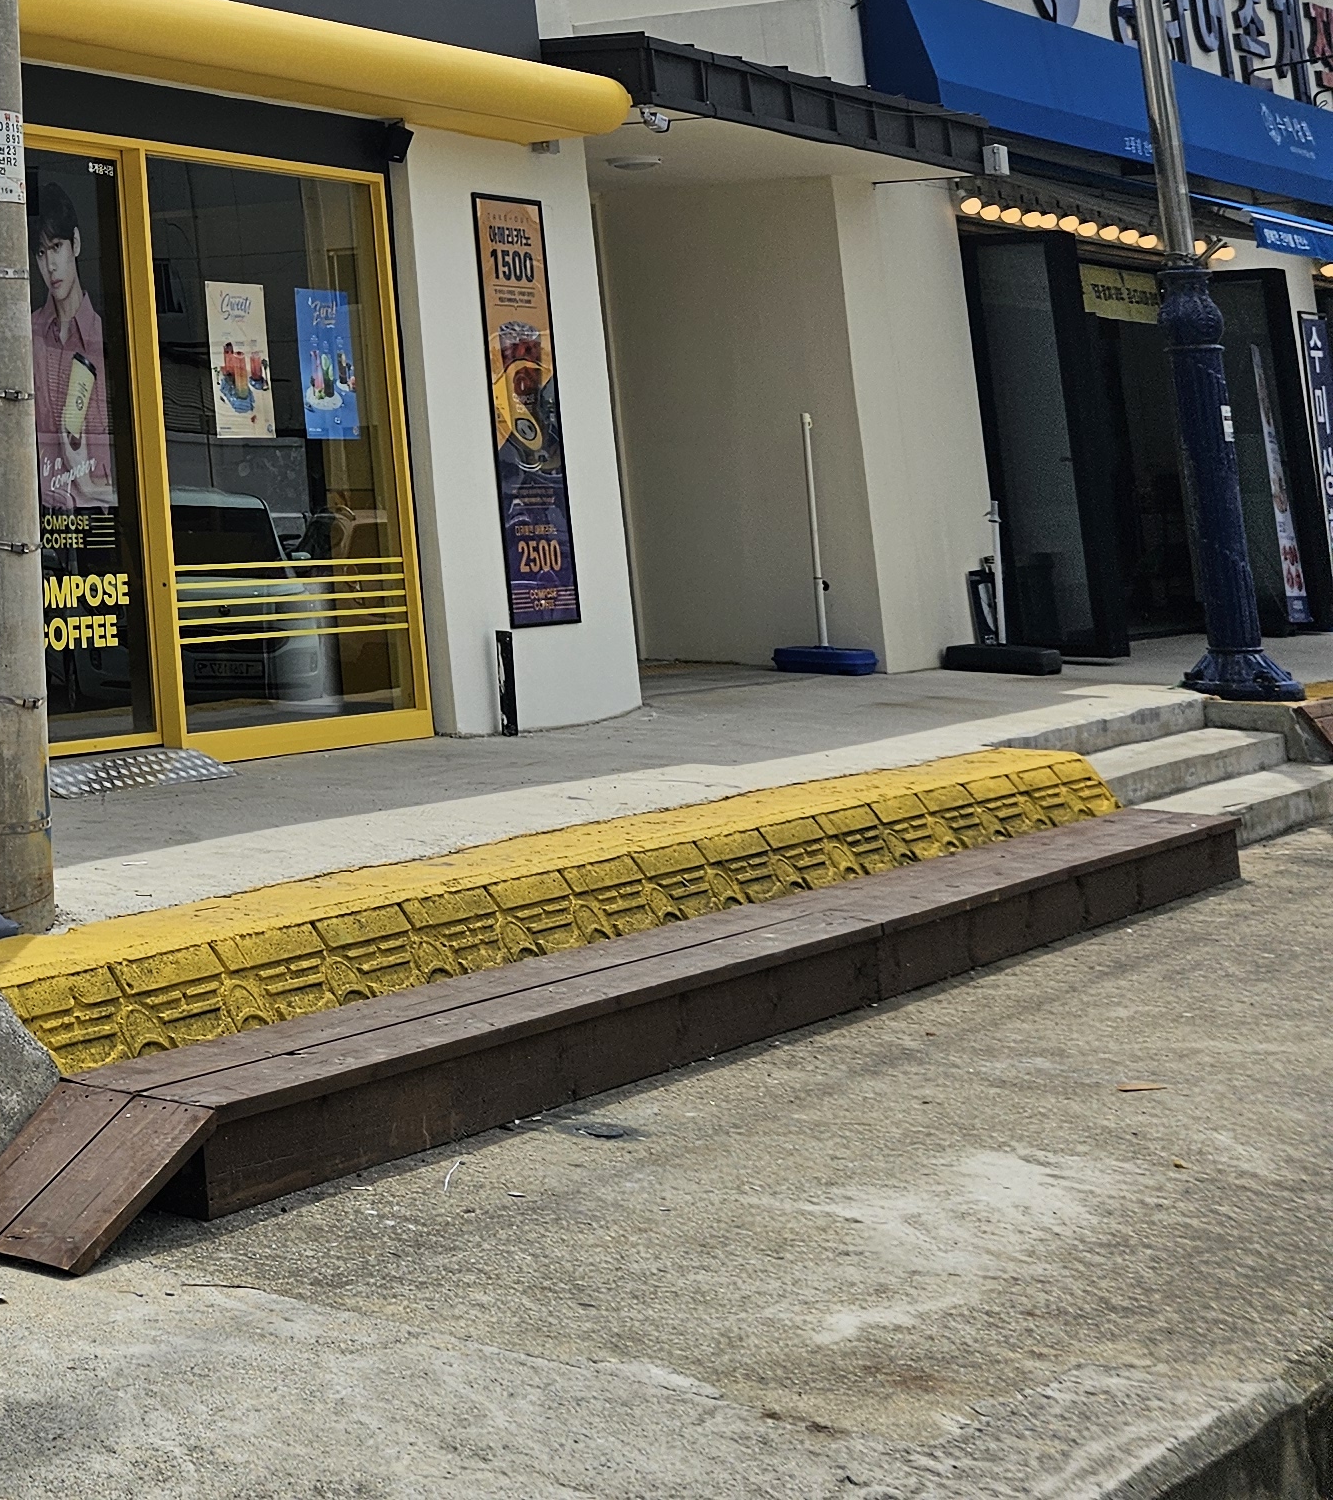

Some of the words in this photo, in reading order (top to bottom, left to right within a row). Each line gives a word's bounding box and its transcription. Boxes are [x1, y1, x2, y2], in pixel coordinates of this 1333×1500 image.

[489, 224, 532, 247] 아메리카노
[490, 248, 535, 283] 1500
[42, 515, 90, 531] OMPOSE
[44, 533, 85, 548] COFFEE
[518, 539, 561, 573] 2500
[43, 614, 119, 651] OFFEE
